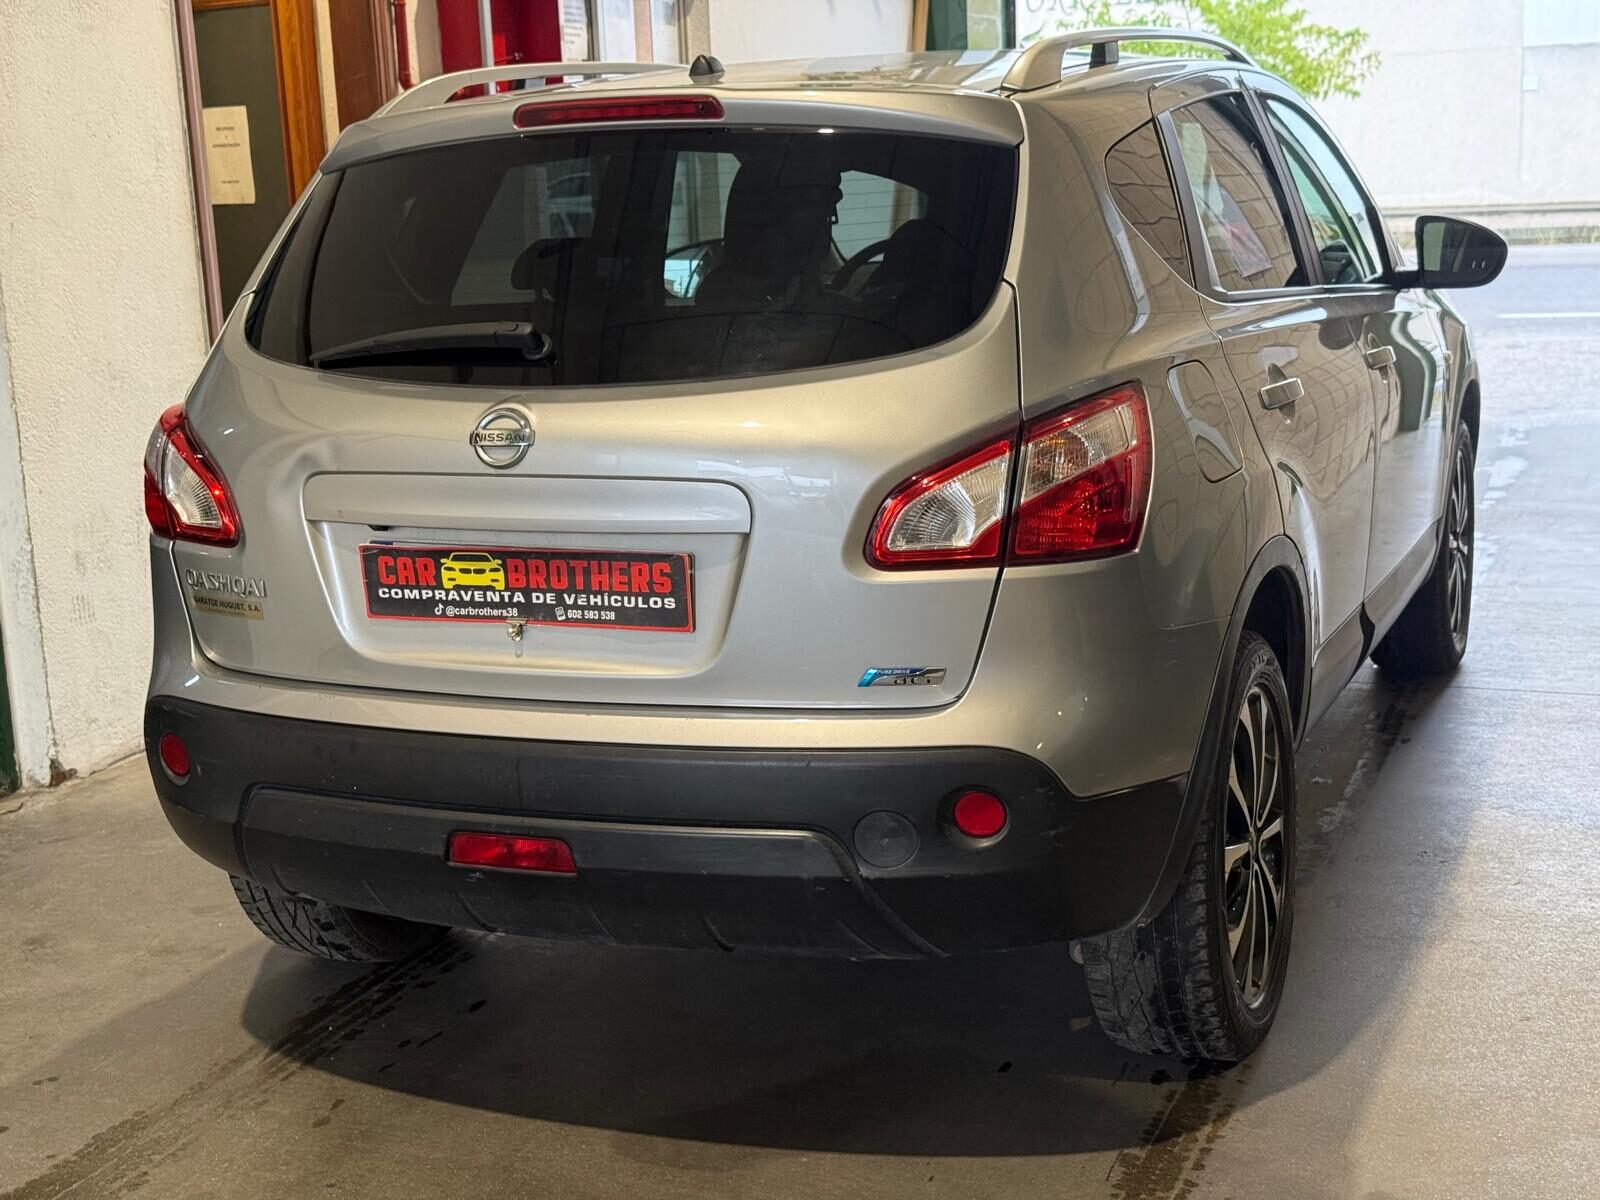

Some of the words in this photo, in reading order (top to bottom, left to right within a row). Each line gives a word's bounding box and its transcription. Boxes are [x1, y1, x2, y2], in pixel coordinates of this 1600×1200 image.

[474, 433, 525, 443] NISSAN
[377, 555, 437, 586] CAR
[506, 558, 673, 593] BROTHERS
[185, 568, 268, 598] QASHQAI
[378, 587, 526, 604] COMPRAVENTA
[531, 592, 557, 605] DE
[563, 592, 677, 609] VEHÍCULOS
[446, 606, 519, 617] @carbrothers38
[567, 609, 583, 619] 602
[584, 610, 599, 620] 583
[600, 610, 616, 620] 538
